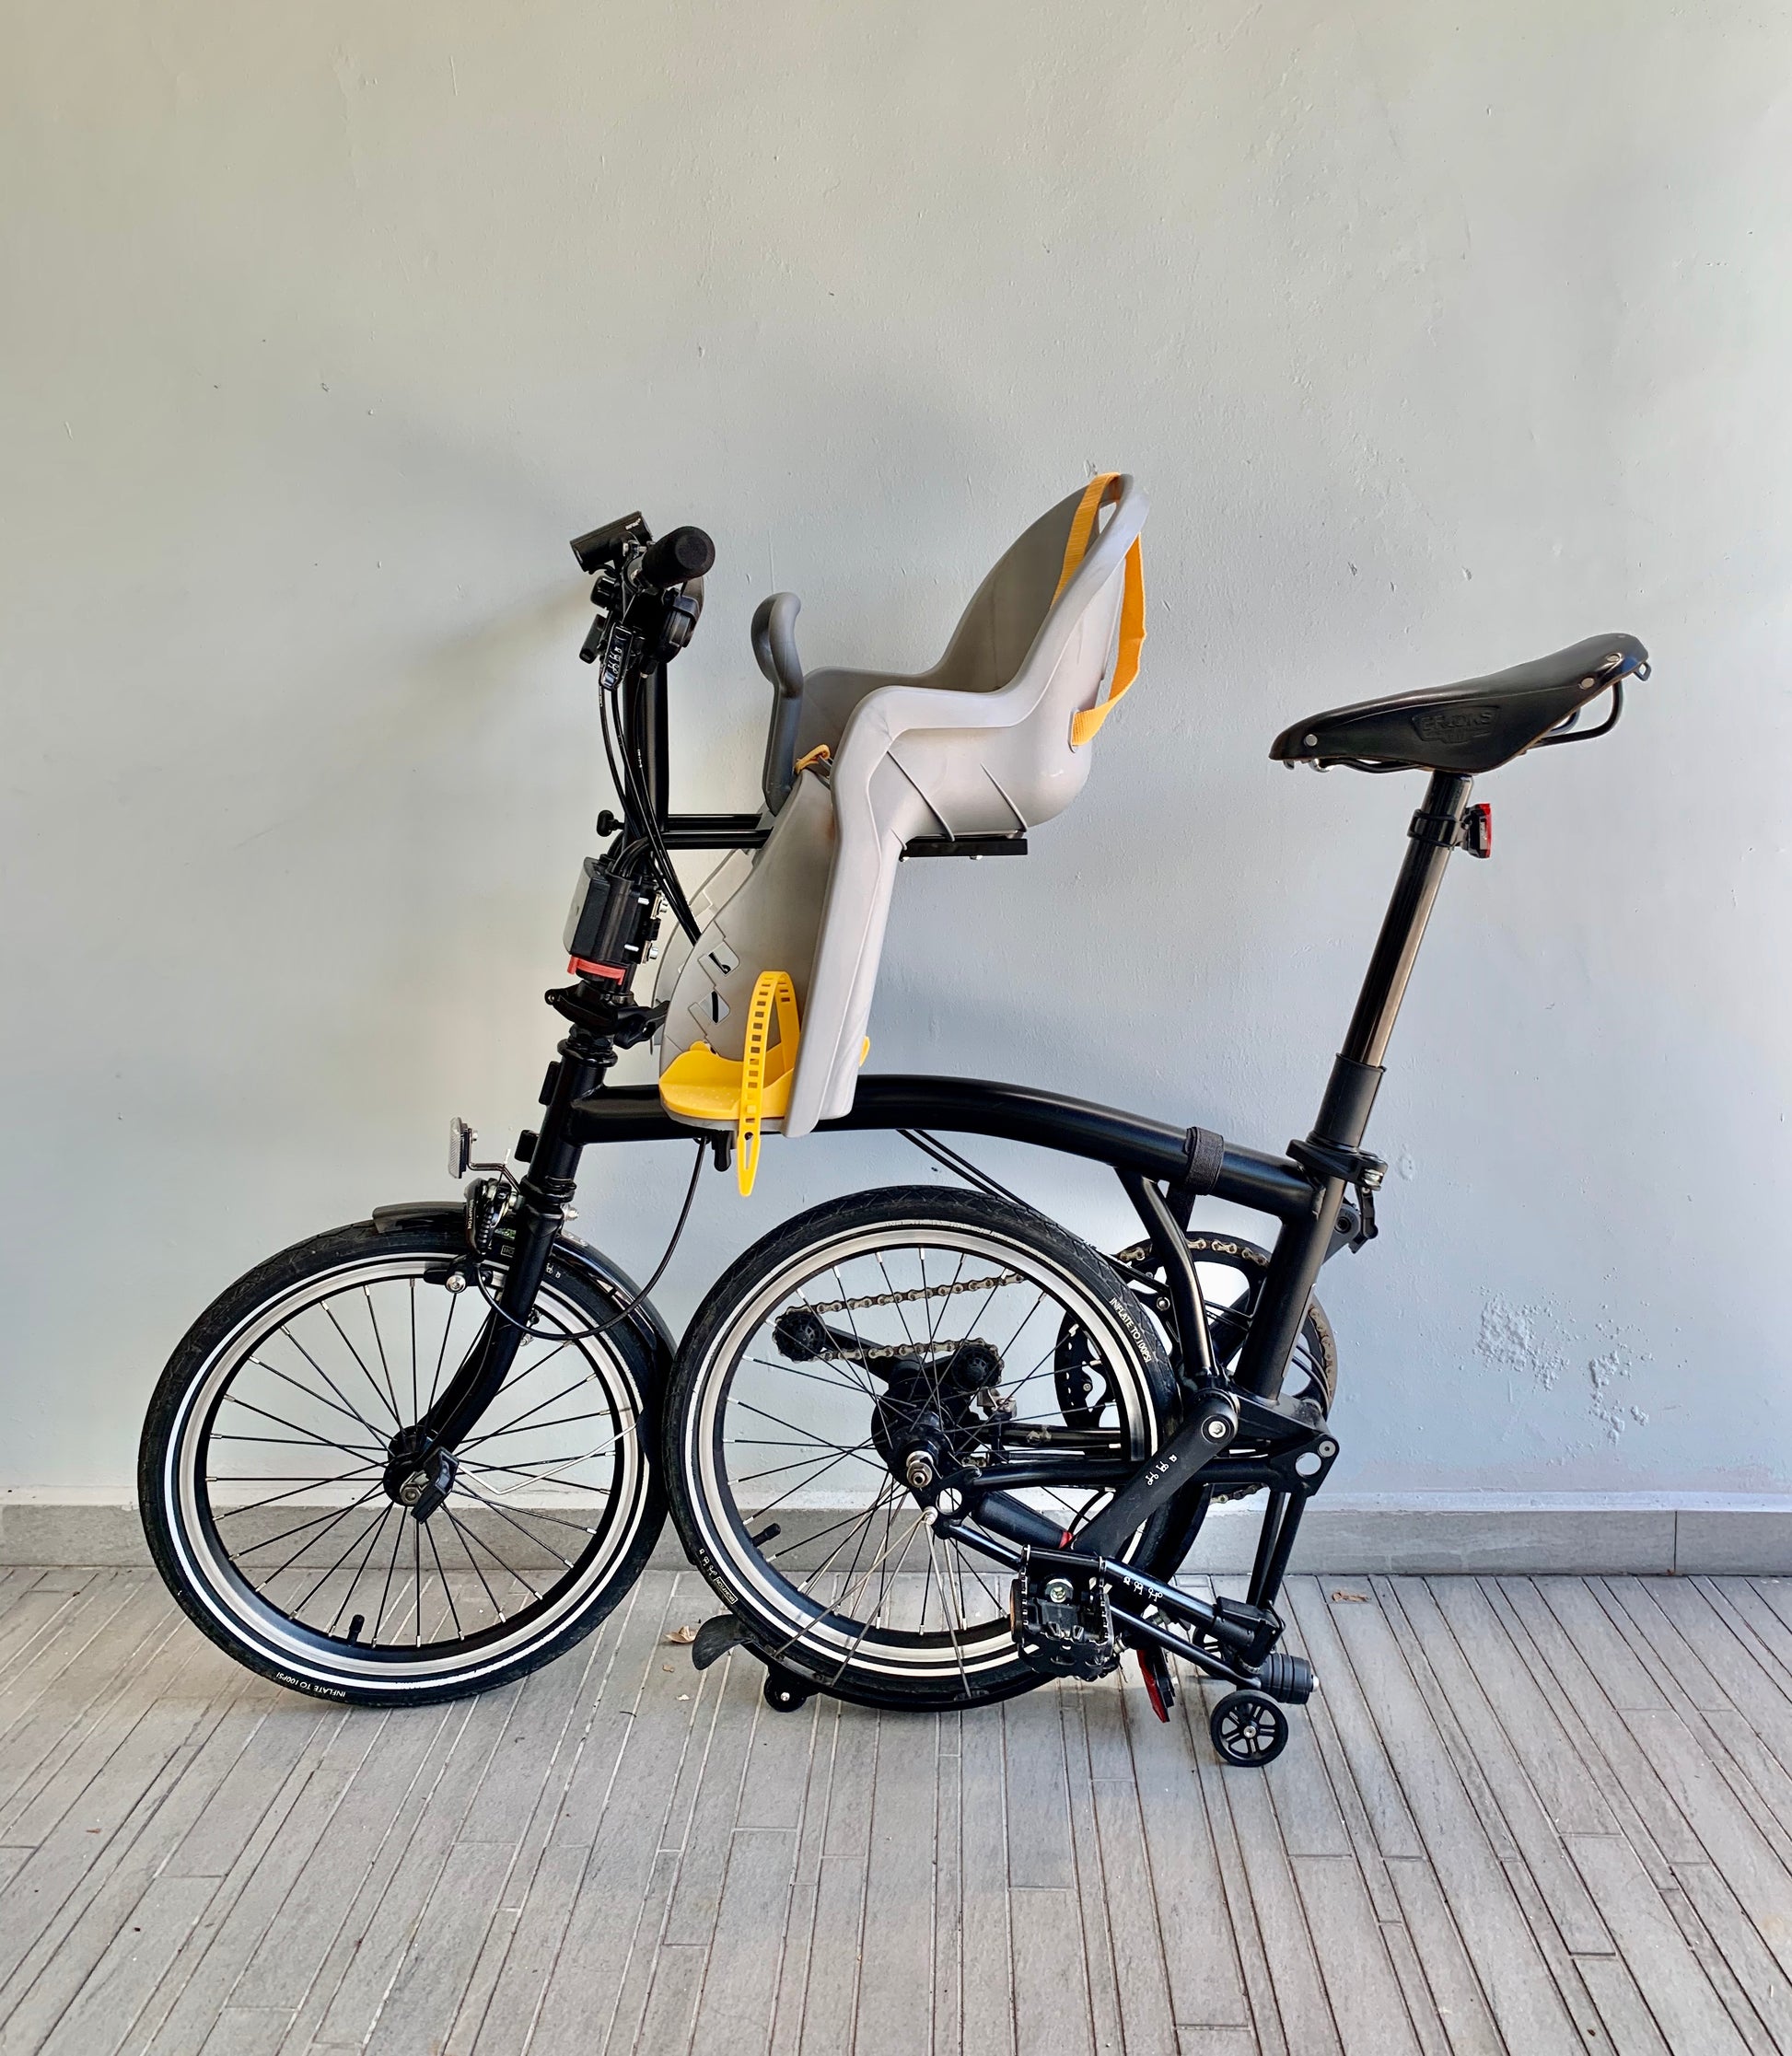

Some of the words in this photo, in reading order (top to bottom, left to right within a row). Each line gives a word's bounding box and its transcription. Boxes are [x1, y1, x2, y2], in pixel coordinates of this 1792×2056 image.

[1109, 1297, 1135, 1328] INFLATE
[1130, 1327, 1141, 1340] TO
[275, 1671, 299, 1686] 100PSI
[299, 1681, 311, 1690] TO
[313, 1685, 346, 1698] INFLATE
